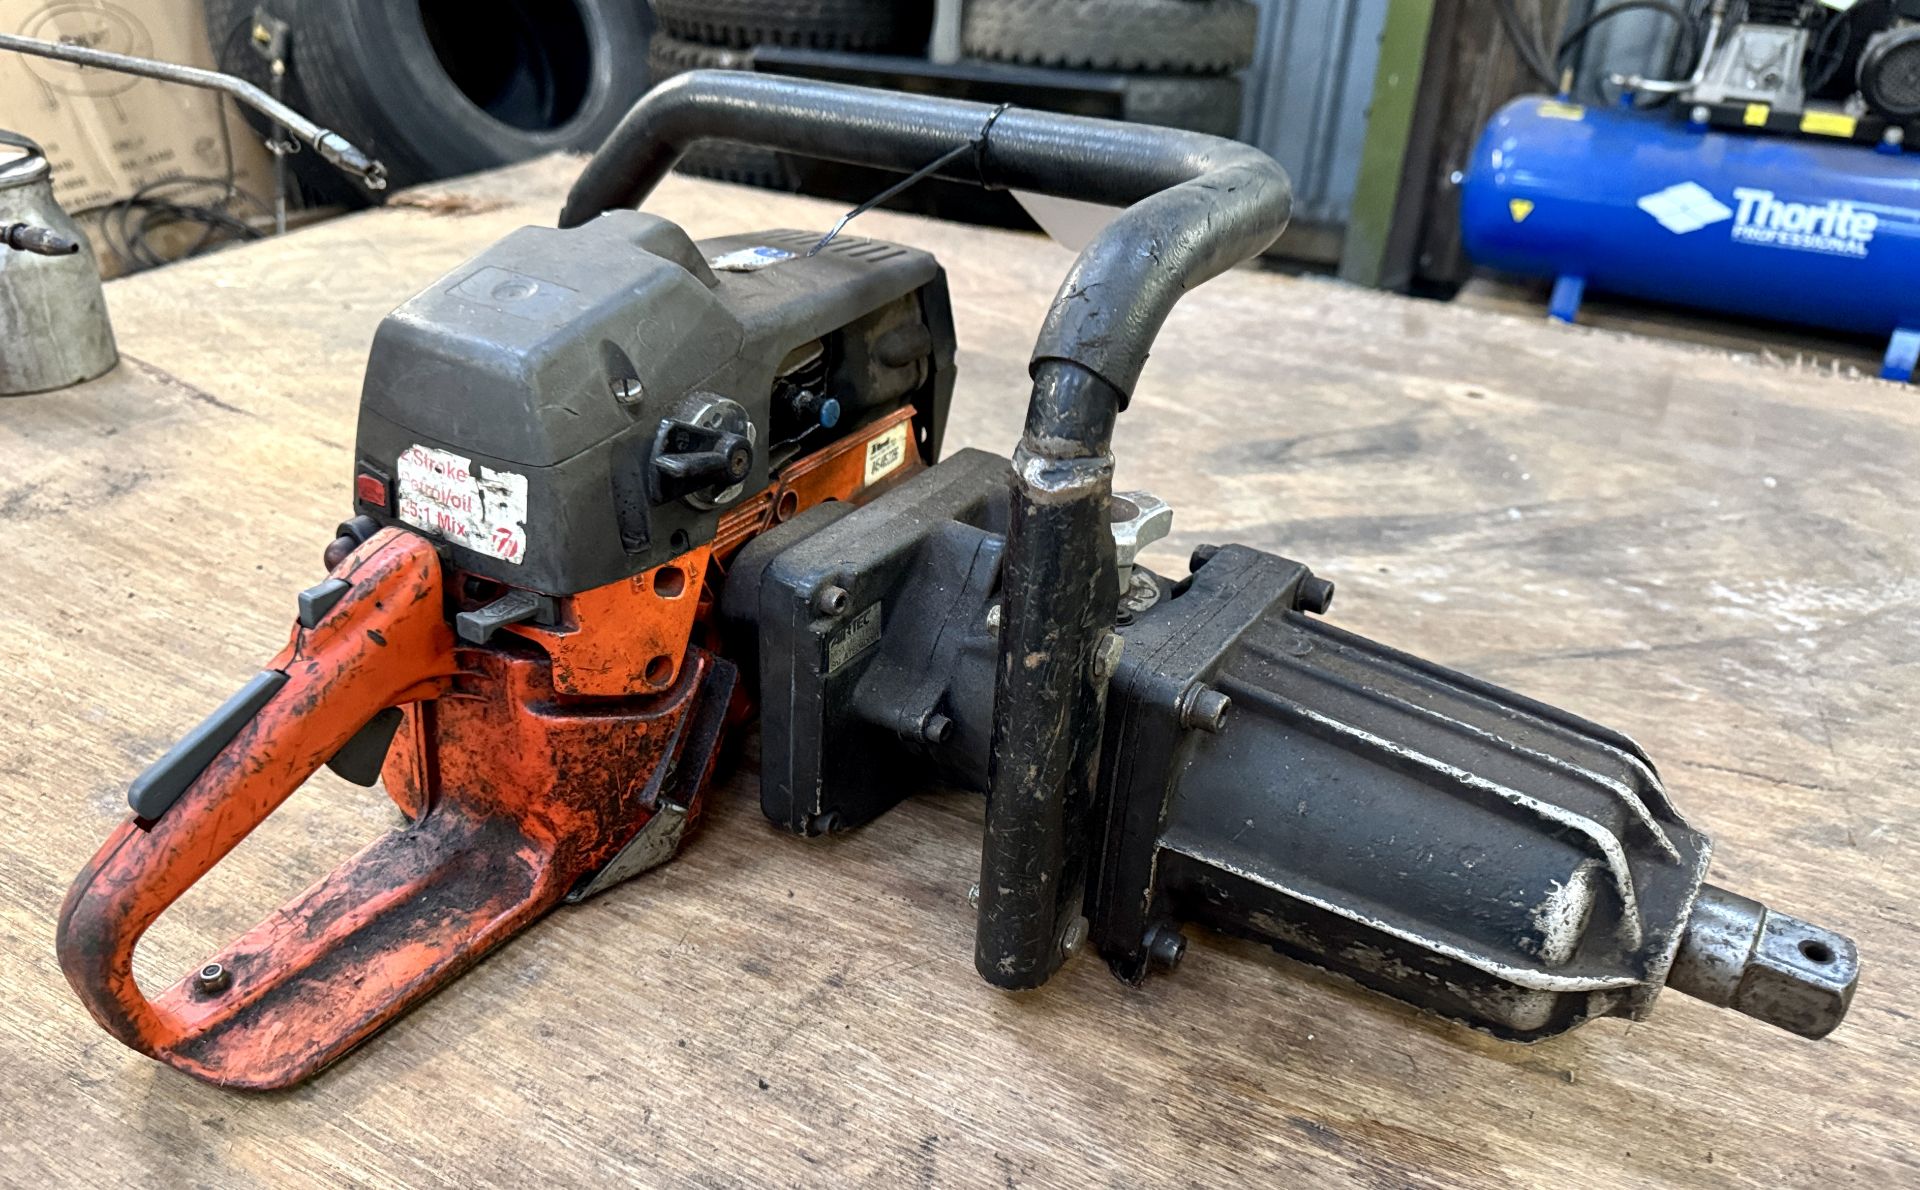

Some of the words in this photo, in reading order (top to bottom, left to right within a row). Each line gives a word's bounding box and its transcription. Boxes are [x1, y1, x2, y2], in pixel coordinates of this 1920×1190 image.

[1733, 187, 1878, 242] Thorite
[413, 448, 469, 483] Stroke
[437, 511, 466, 536] Mix
